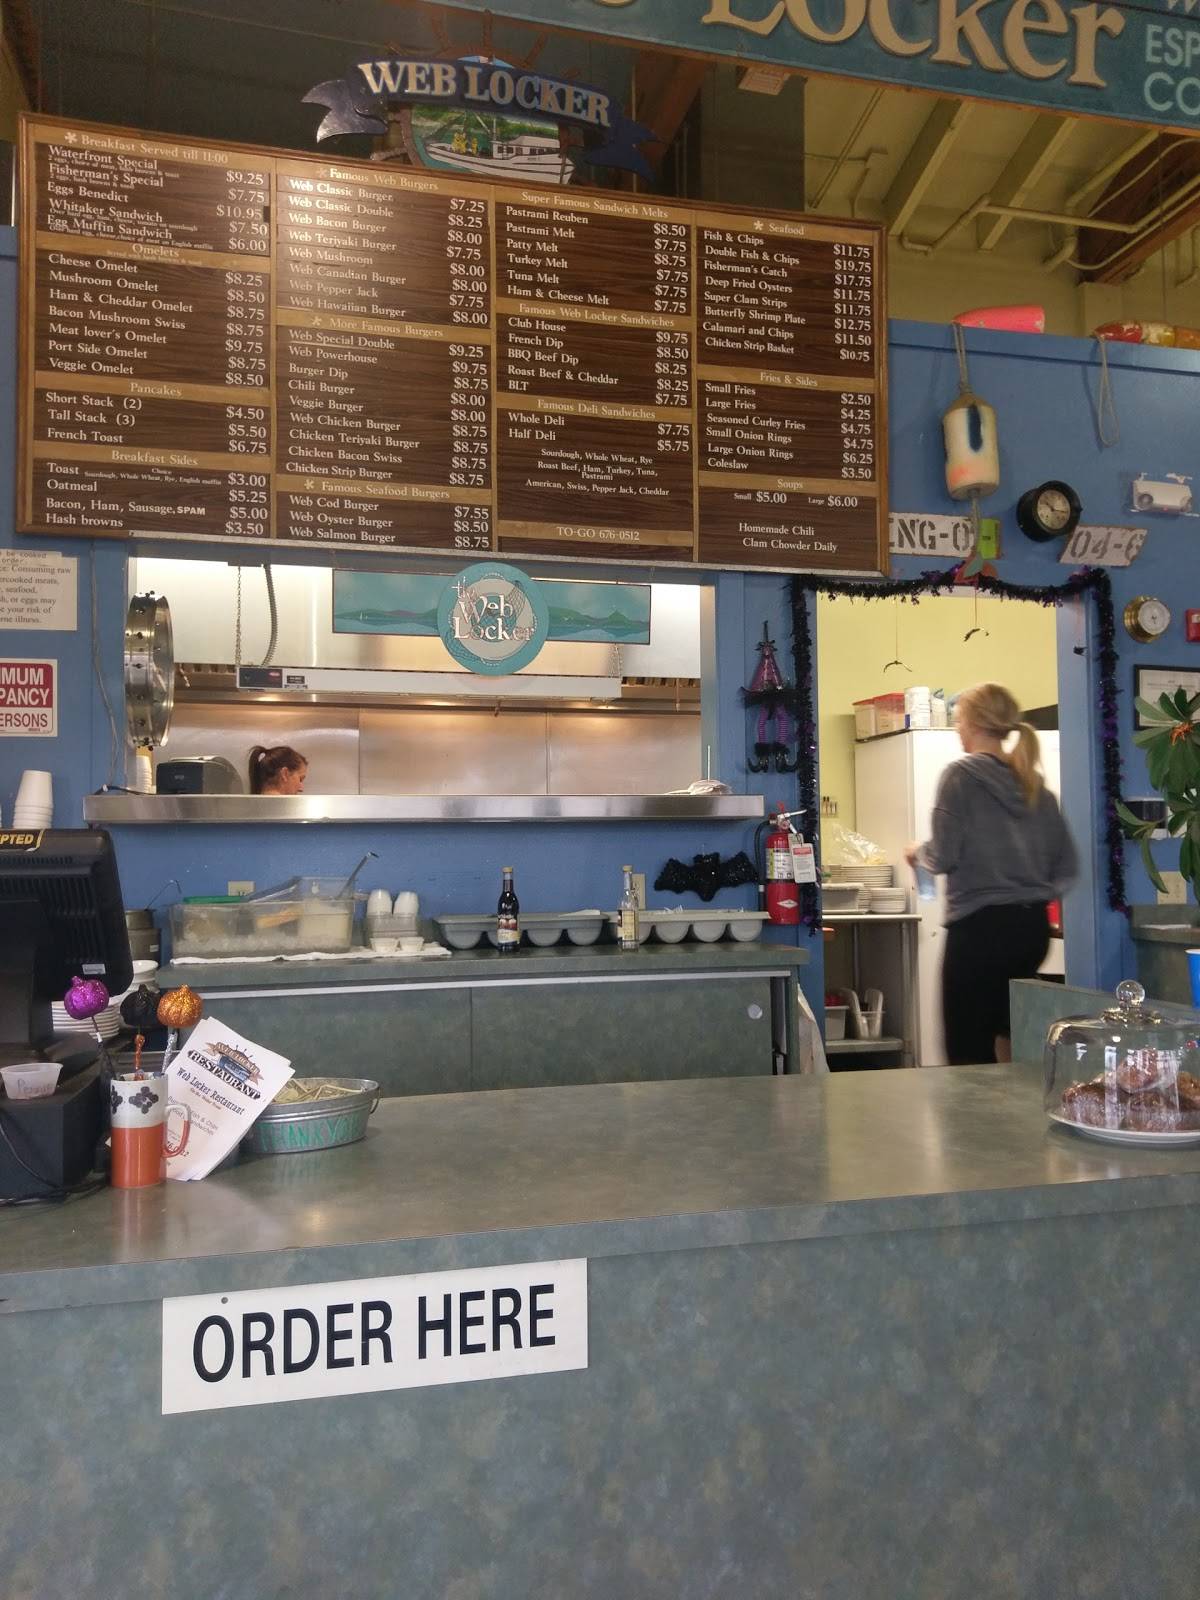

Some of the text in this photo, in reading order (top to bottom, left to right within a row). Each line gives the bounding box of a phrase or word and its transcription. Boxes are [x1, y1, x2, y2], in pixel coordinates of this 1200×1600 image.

[357, 61, 611, 128] WEB LOCKER
[81, 135, 136, 153] Breakfast
[139, 142, 179, 158] Served
[183, 147, 199, 160] till
[329, 167, 439, 192] Famous Web Burgers
[47, 182, 74, 197] Eggs
[79, 187, 129, 203] Benedict
[216, 205, 263, 220] $10.95
[288, 196, 483, 228] Web Classic Double $8.25
[47, 215, 69, 229] Egg
[73, 219, 114, 233] Muffin
[118, 224, 173, 240] Sandwich
[228, 238, 266, 251] $6.00
[506, 223, 687, 253] Pastrami Melt $7.75
[288, 247, 485, 276] Web Mushroom $8.00
[507, 253, 689, 283] Turkey Melt $7.75
[705, 245, 871, 273] Double Fish & Chips $19.75
[49, 271, 265, 304] Mushroom Omelet $8.50
[288, 279, 484, 308] Web Pepper Jack $7.75
[705, 276, 871, 301] Deep Fried Oysters $11.75
[49, 306, 264, 337] Bacon Mushroom Swiss $8.75
[519, 303, 675, 327] Famous Web Locker Sandwiches
[288, 329, 484, 358] Web Special Double $9.25
[508, 333, 689, 359] French Dip $8.50
[702, 321, 872, 346] Calamari and Chips $11.50
[49, 357, 264, 386] Veggie Omelet $8.50
[288, 362, 489, 390] Burger Dip $8.75
[760, 372, 818, 387] Fries & Sides
[45, 391, 265, 421] Short Stack (2) $4.50
[537, 400, 656, 420] Famous Deli Sandwiches
[290, 412, 488, 438] Web Chicken Burger $8.75
[707, 413, 871, 435] Seasoned Curley Fries $4.75
[508, 428, 689, 452] Half Deli $5.75
[111, 450, 199, 466] Breakfast Sides
[288, 446, 487, 470] Chicken Bacon Swiss $8.75
[707, 443, 873, 465] Large Onion Rings $6.25
[581, 471, 613, 481] Pastrami
[46, 479, 267, 503] Oatmeal $5.25
[734, 491, 858, 508] Small $5.00 Large $6.00
[289, 495, 489, 519] Web Cod Burger $7.55
[289, 526, 490, 549] Web Salmon Burger $8.75
[557, 526, 640, 541] TO-GO 676-0512
[742, 537, 838, 552] Clam Chowder Daily
[459, 595, 514, 623] Web
[453, 617, 534, 641] Locker
[189, 1051, 260, 1099] RESTAURANT
[176, 1067, 190, 1082] Web
[190, 1075, 211, 1095] Locker
[211, 1090, 245, 1116] Restaurant
[192, 1283, 556, 1383] ORDER HERE
